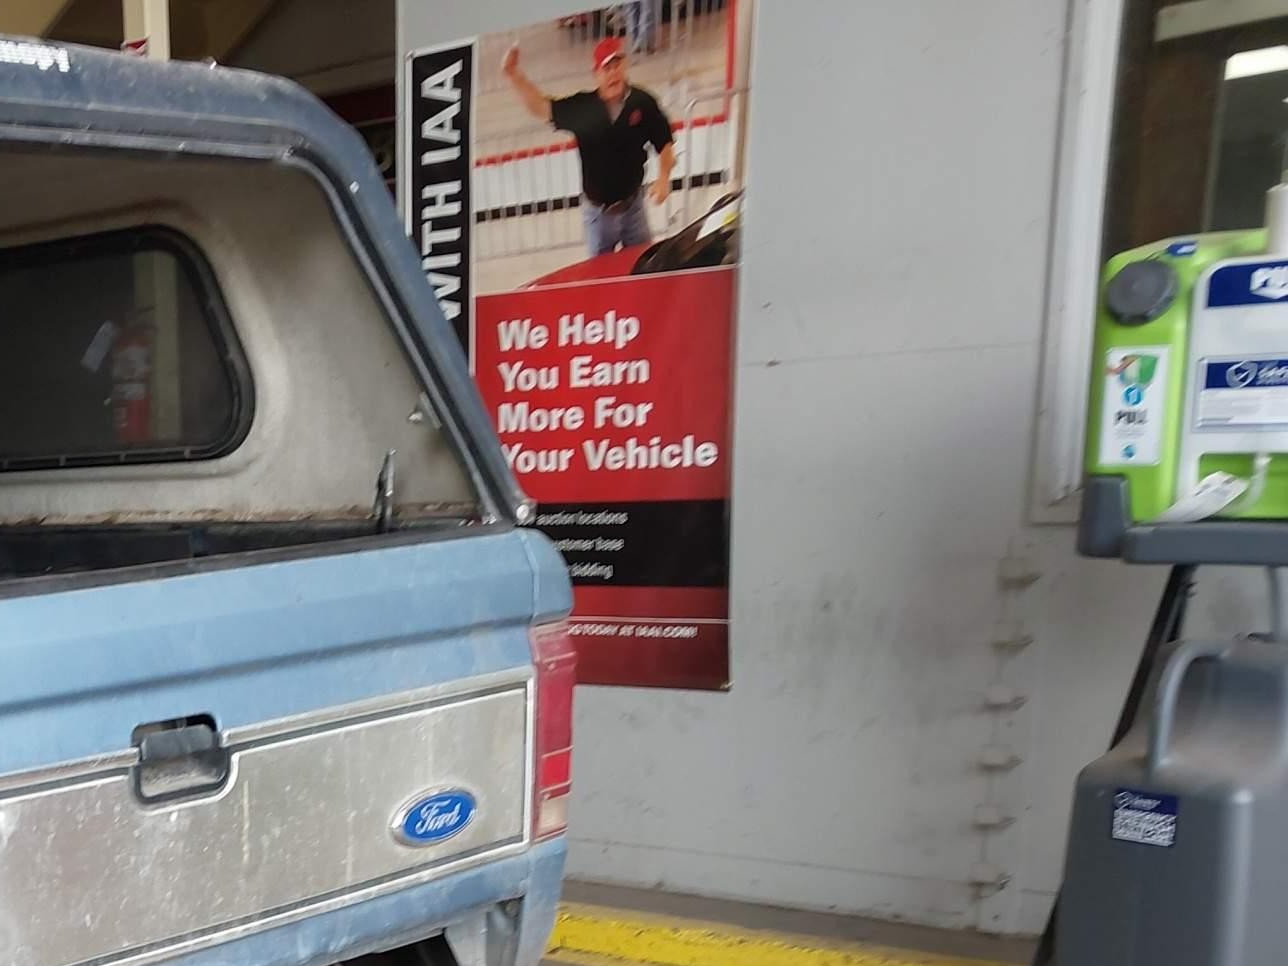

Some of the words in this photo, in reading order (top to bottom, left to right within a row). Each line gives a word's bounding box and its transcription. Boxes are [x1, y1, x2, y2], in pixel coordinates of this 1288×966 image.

[421, 59, 463, 165] IAA
[421, 179, 463, 321] WITH
[497, 319, 550, 351] We
[557, 310, 641, 350] Help
[497, 360, 560, 392] You
[569, 355, 650, 388] Earn
[498, 401, 585, 433] More
[594, 396, 654, 429] For
[500, 442, 575, 474] Your
[582, 435, 719, 471] Vehicle
[415, 799, 462, 835] Ford
